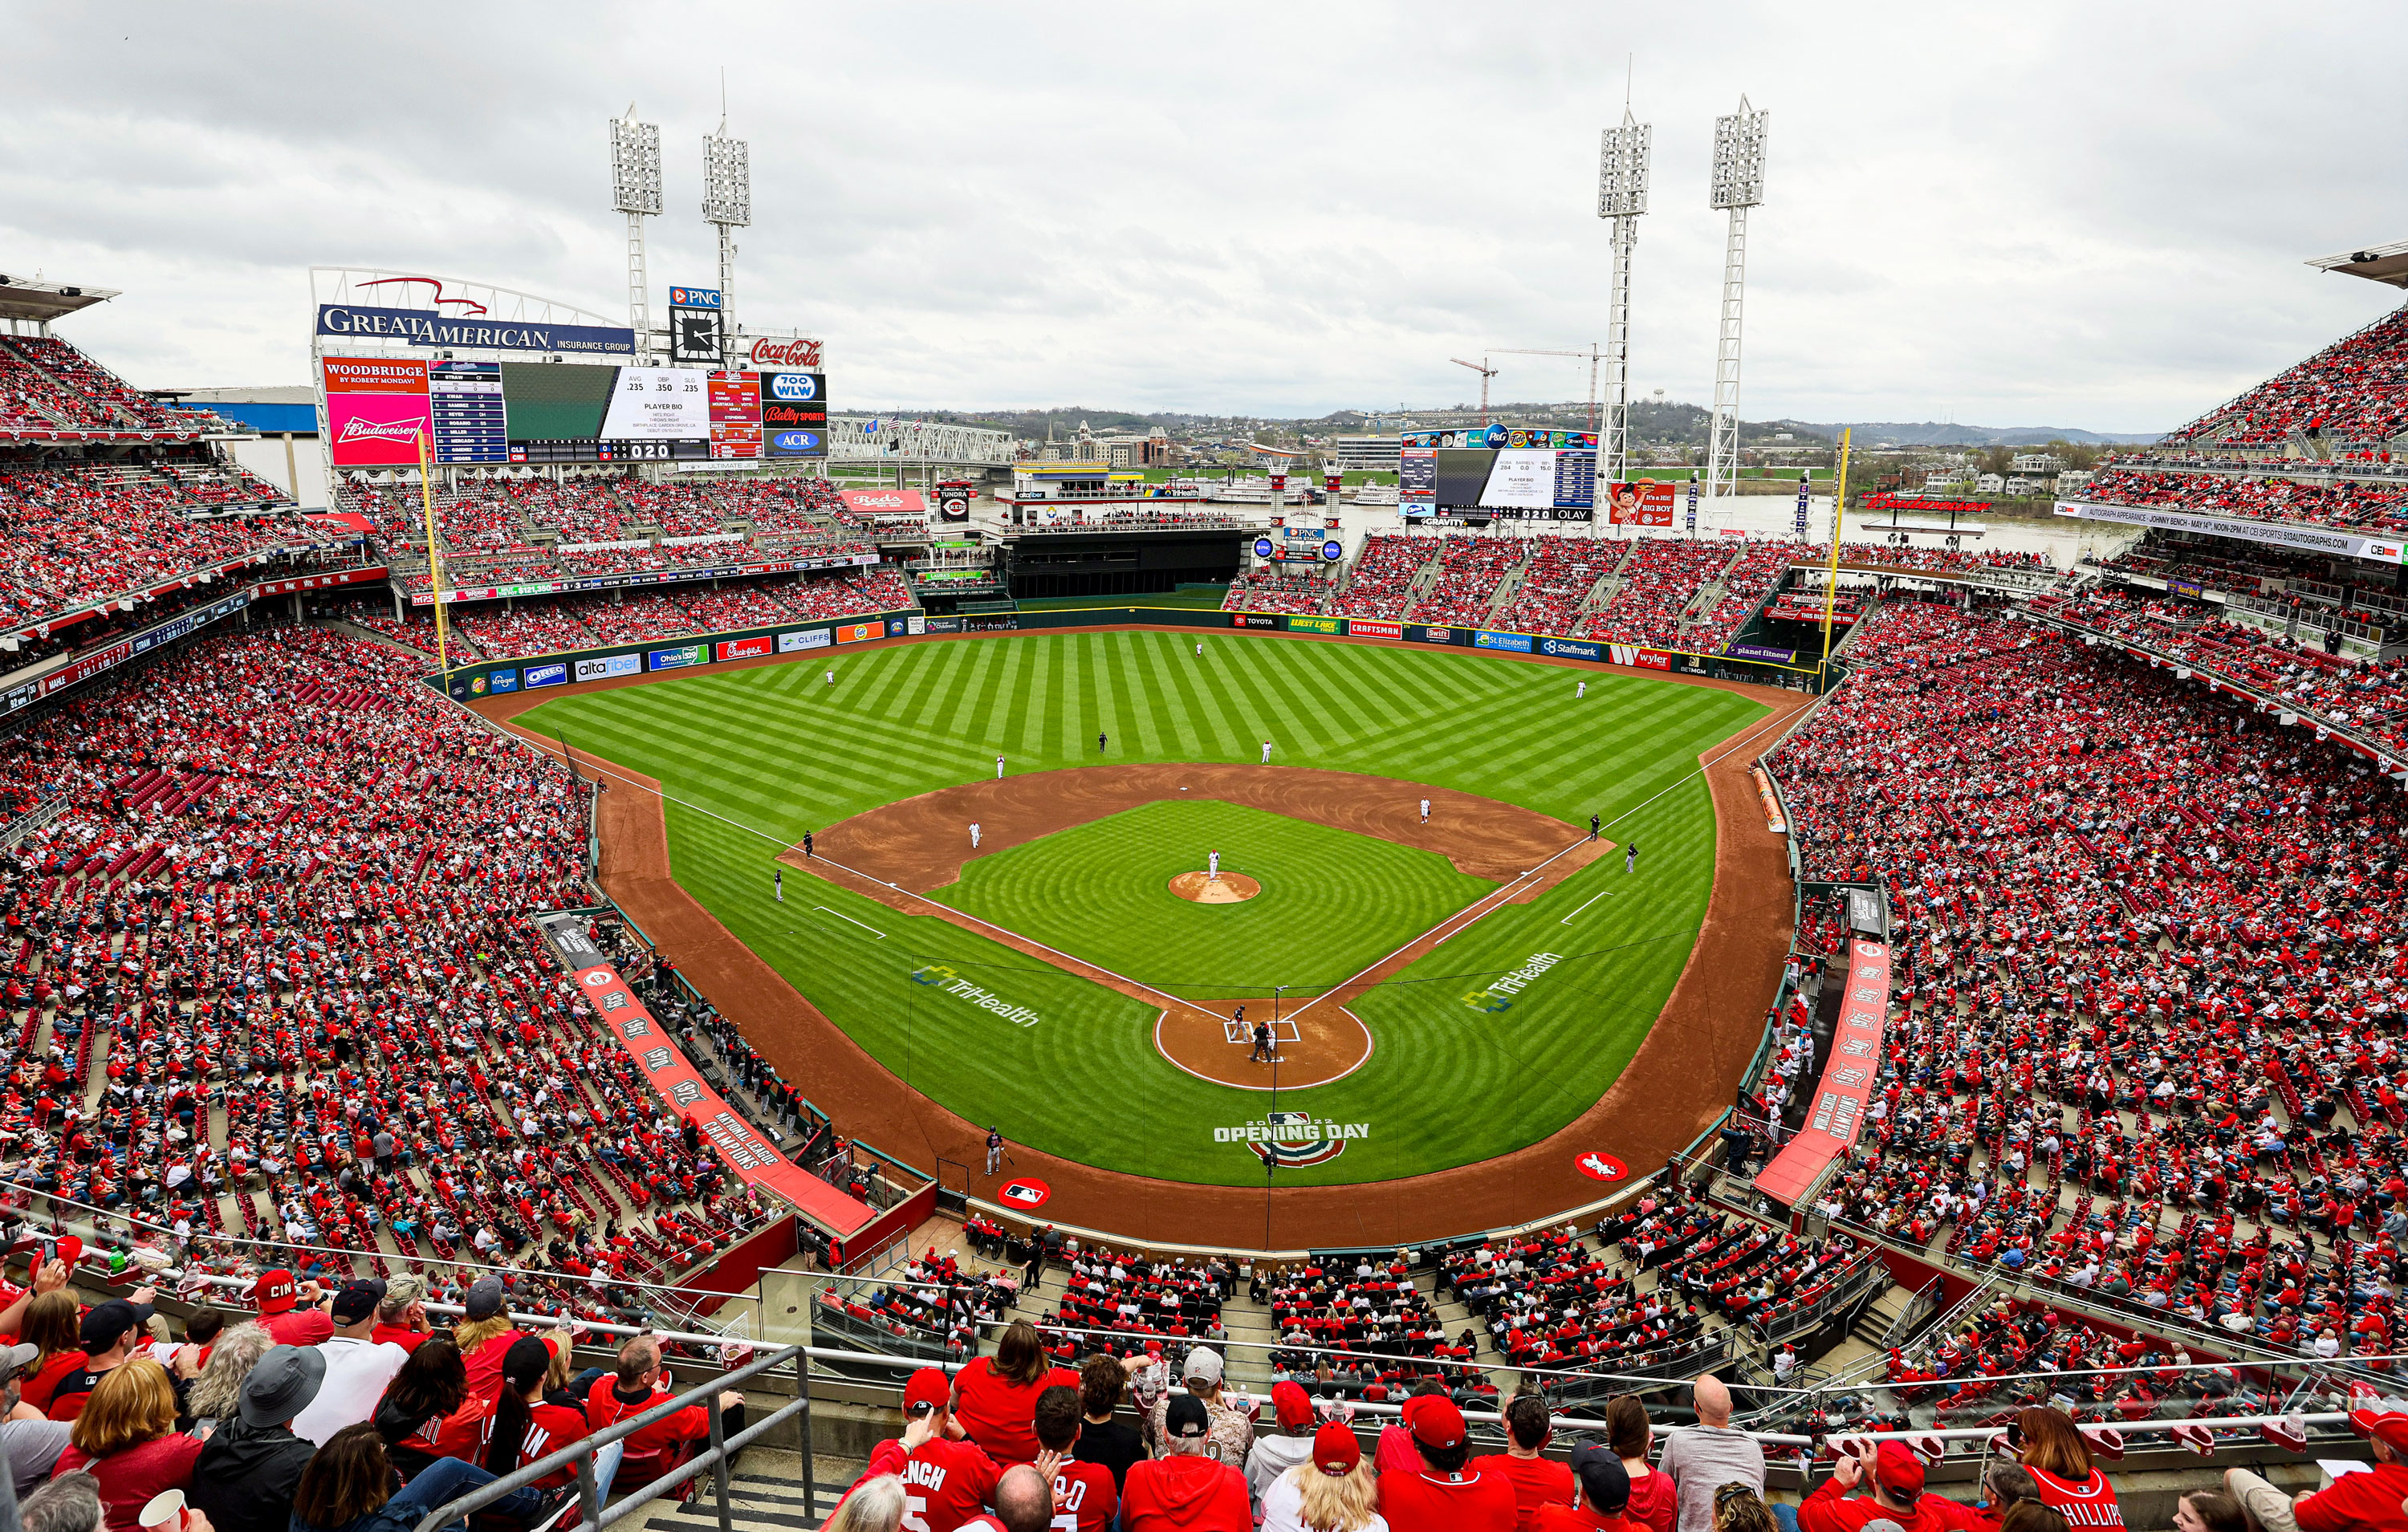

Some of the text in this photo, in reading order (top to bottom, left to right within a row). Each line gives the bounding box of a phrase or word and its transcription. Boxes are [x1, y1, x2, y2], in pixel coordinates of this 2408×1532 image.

[689, 290, 719, 306] PNC
[557, 339, 631, 352] INSURANCE GROUP
[751, 338, 823, 367] Coca-Cola
[326, 364, 425, 376] WOODBRIDGE
[781, 376, 807, 385] 700
[777, 386, 811, 396] WLW
[765, 406, 826, 425] Bally SPORTS
[344, 422, 418, 436] Budweiser
[782, 434, 810, 446] ACR
[1488, 431, 1507, 442] P&G
[1510, 434, 1525, 444] Tide
[632, 445, 668, 458] 0 2 0
[853, 494, 904, 506] Reds
[1171, 489, 1198, 497] TriHealth
[1862, 491, 1992, 512] Budweiser
[1558, 510, 1587, 520] OLAY
[2057, 505, 2348, 550] CEI AUTOGRAPH APPEARANCE JOHNNY BENCH MAY NOON-2PM AT CEI SPORTS! 513AUTOGRAPHS.COM
[2371, 544, 2384, 555] CEI
[519, 584, 551, 595] $121,350
[2178, 584, 2200, 598] Hard Rock
[413, 595, 434, 603] MPS
[1291, 619, 1336, 629] WEST LAKE
[1352, 624, 1400, 635] CRAFTSMAN
[798, 633, 829, 644] CLIFFS
[856, 628, 866, 639] Tide
[1429, 630, 1447, 638] Swift
[136, 638, 151, 652] STRAW
[1499, 636, 1530, 647] Elizabeth
[660, 651, 697, 662] Ohio's 529
[1557, 644, 1596, 656] Staffmark
[1738, 647, 1788, 660] planet fitness
[579, 658, 637, 676] altafiber
[1640, 654, 1668, 667] wyler
[527, 665, 565, 684] OREO
[1681, 666, 1706, 676] BETMGM
[29, 676, 66, 694] 30 MAHLE
[492, 676, 515, 688] Kroger
[10, 699, 18, 709] 92
[1487, 952, 1564, 994] TriHealth
[606, 991, 624, 1009] 1939
[946, 978, 1039, 1027] TriHealth
[1851, 1013, 1875, 1028] 1975
[625, 1019, 645, 1037] 1961
[1845, 1038, 1869, 1056] 1940
[648, 1048, 669, 1068] 1970
[1837, 1063, 1863, 1085] 1919
[676, 1081, 702, 1105] 1972
[1812, 1091, 1838, 1131] WORLD SERIES
[1829, 1094, 1860, 1140] CHAMPIONS
[714, 1111, 780, 1166] NATIONAL LEAGUE
[1214, 1124, 1370, 1143] OPENING DAY
[701, 1120, 761, 1171] CHAMPIONS
[270, 1282, 292, 1298] CIN
[482, 1414, 551, 1458] LAIN
[901, 1460, 947, 1492] ENCH
